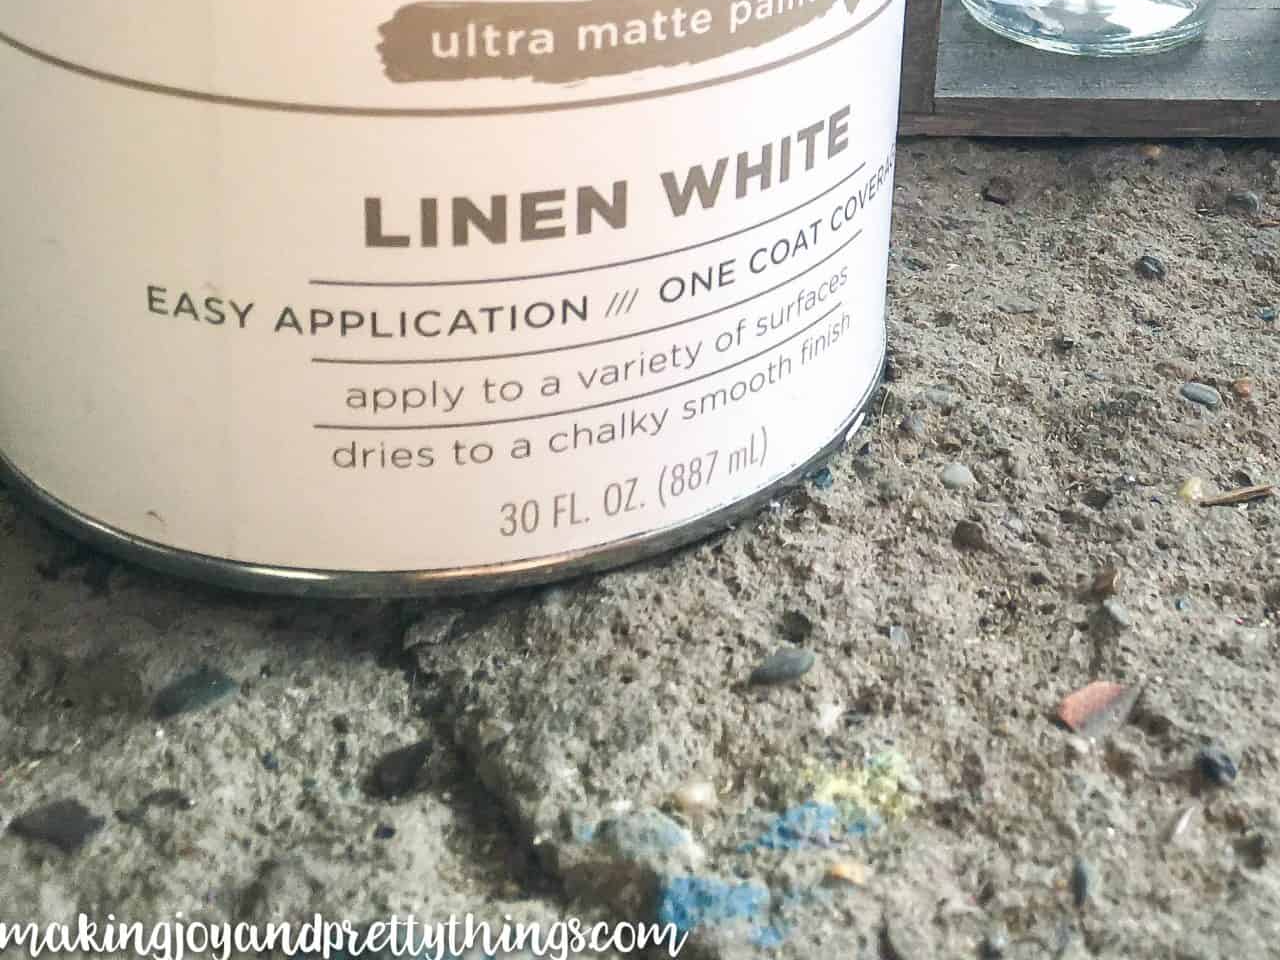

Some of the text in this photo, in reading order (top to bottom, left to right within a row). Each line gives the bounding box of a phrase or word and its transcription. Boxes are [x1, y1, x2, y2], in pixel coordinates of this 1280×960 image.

[430, 24, 556, 60] ultra
[577, 9, 713, 52] matte
[364, 105, 851, 248] LINEN WHITE
[146, 285, 256, 329] EASY
[273, 295, 590, 339] APPLICATION
[658, 259, 737, 306] ONE
[749, 220, 824, 275] COAT
[345, 264, 850, 415] apply to a variety of surfaces
[332, 311, 851, 471] dries to a chalky smooth finish
[499, 501, 541, 537] 30
[552, 493, 591, 529] FL.
[603, 477, 646, 518] OZ.
[658, 451, 721, 510] (887
